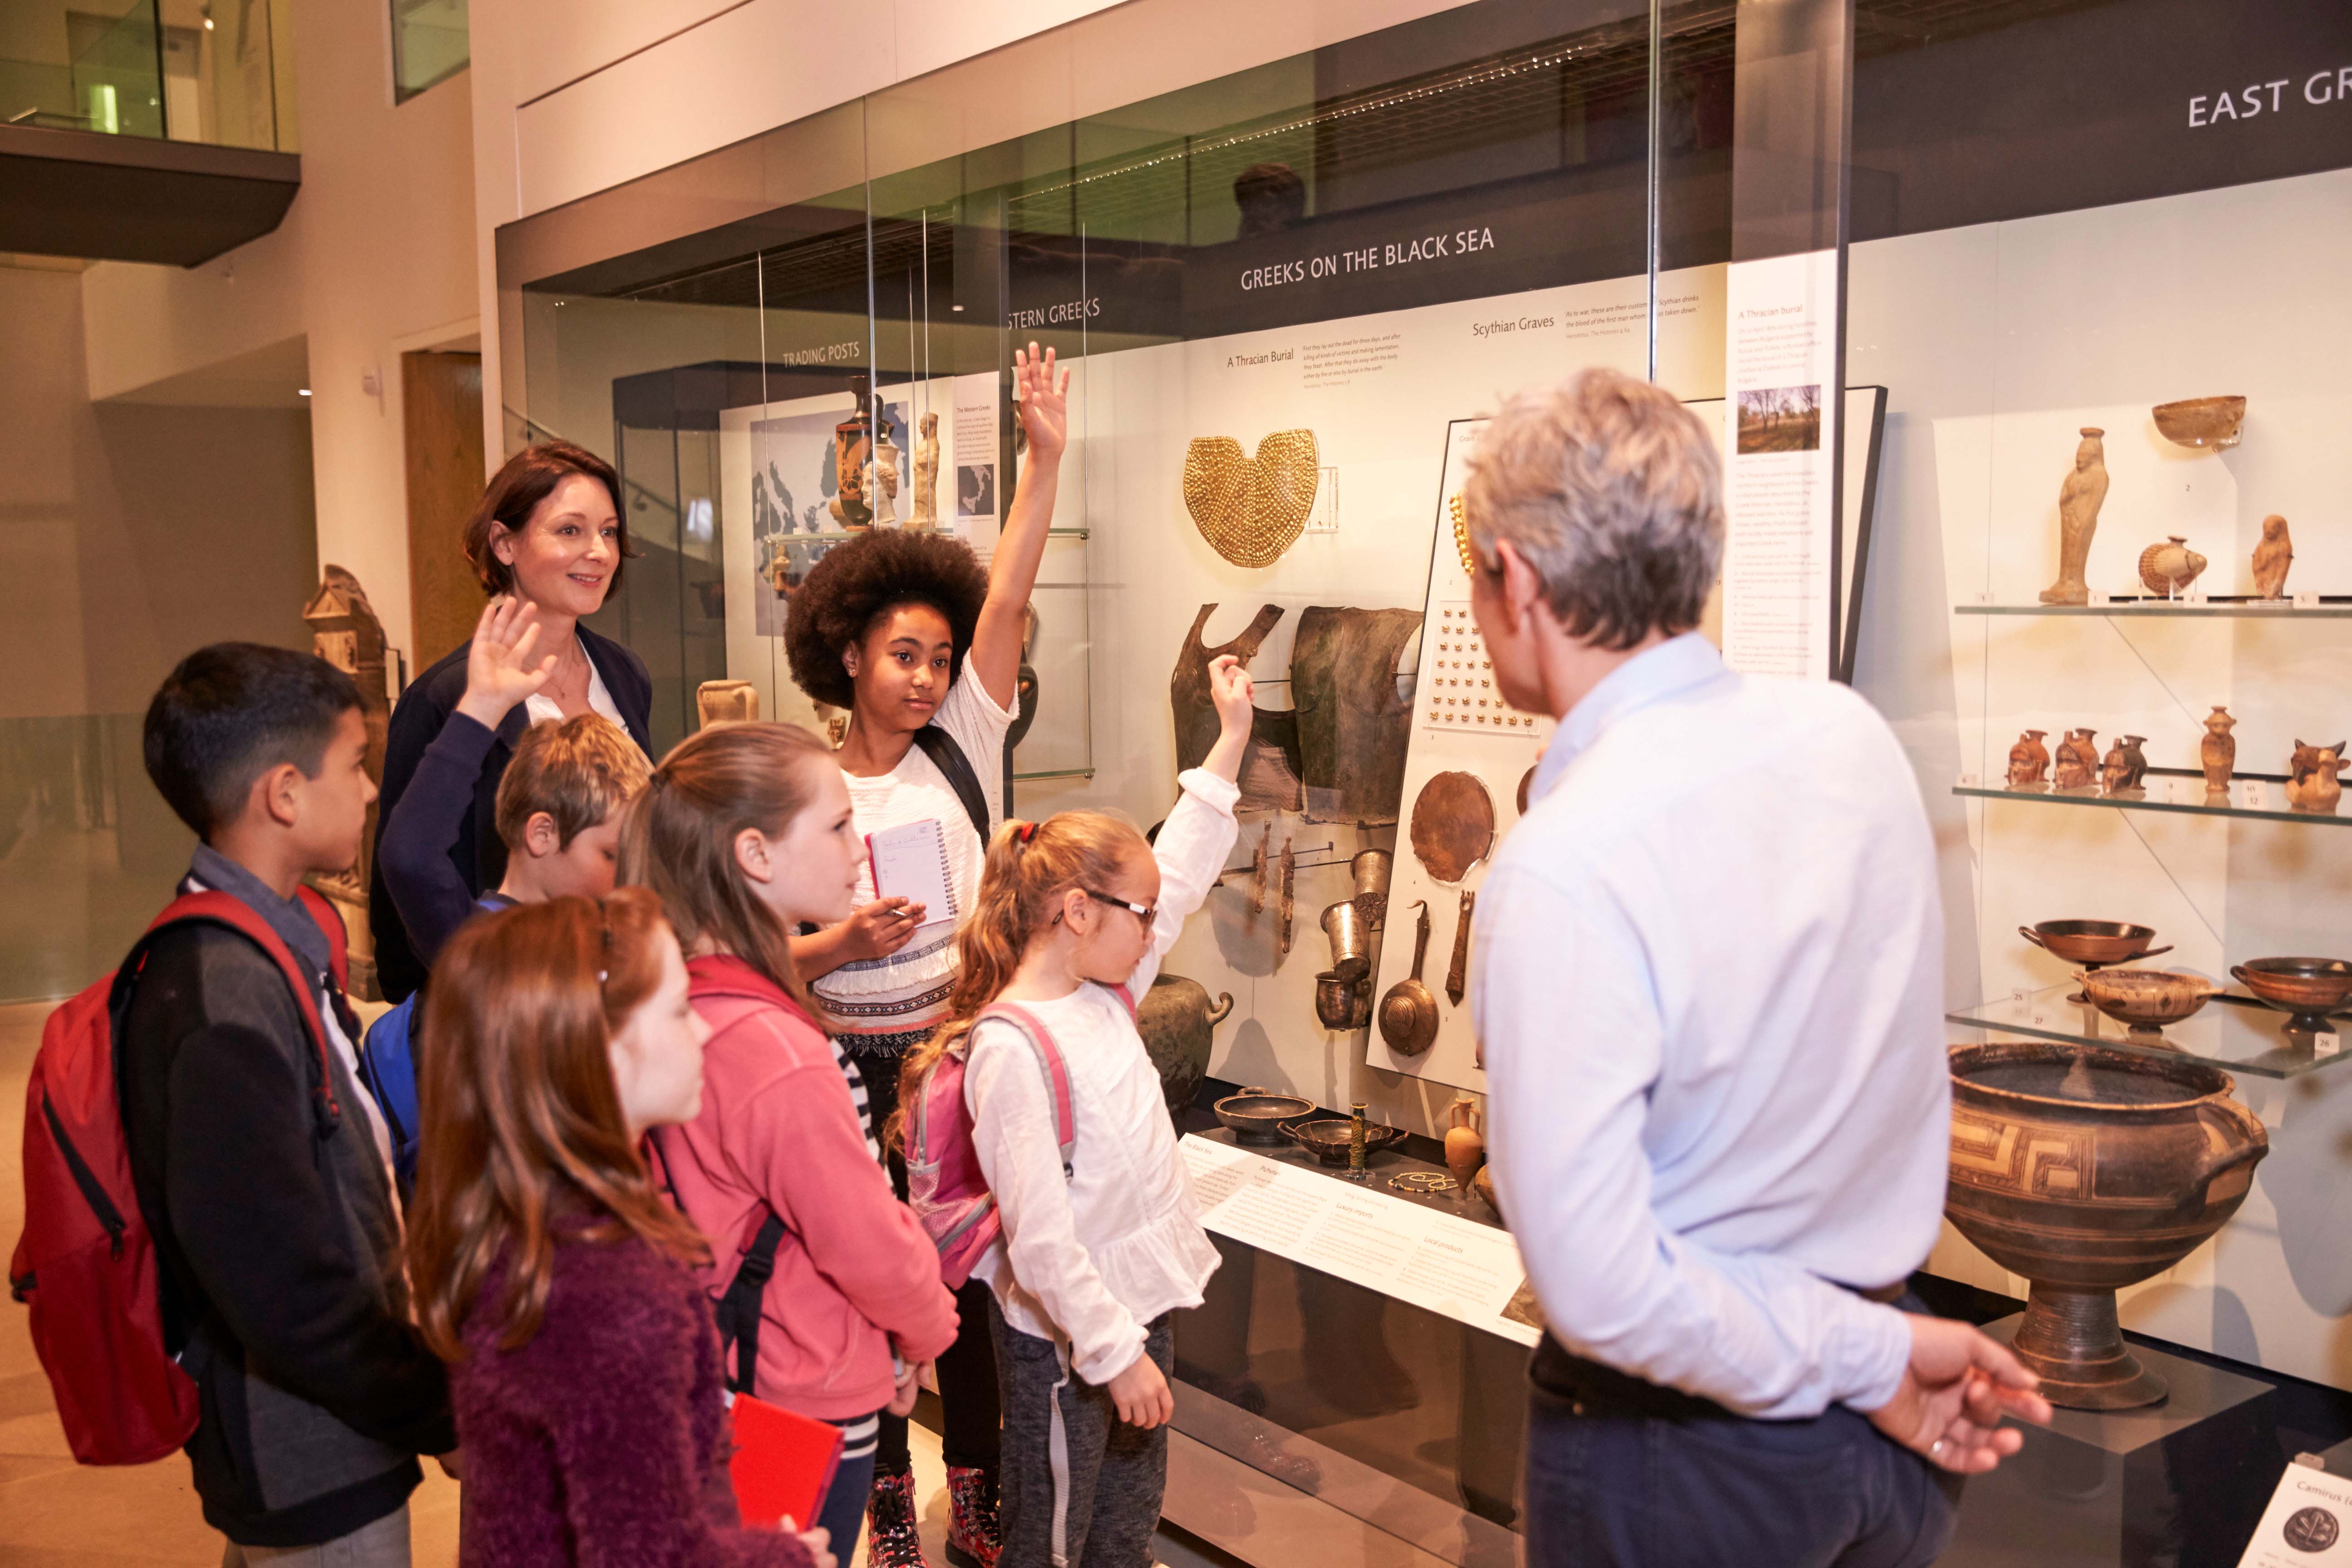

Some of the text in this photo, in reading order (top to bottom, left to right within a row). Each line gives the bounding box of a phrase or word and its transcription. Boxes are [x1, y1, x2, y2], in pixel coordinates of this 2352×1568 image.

[2189, 67, 2352, 127] EAST GR
[1241, 228, 1494, 290] GREEKS ON THE BLACK SEA
[1049, 298, 1100, 323] GREEKS
[1658, 298, 1681, 306] Scythian
[1738, 304, 1803, 319] A Thracian burial
[1473, 317, 1554, 338] Scythian Graves
[1607, 316, 1616, 324] first
[783, 341, 859, 368] TRADING POSTS
[1227, 348, 1293, 368] A Thracian Burial
[2319, 1039, 2330, 1047] 26
[1192, 1142, 1203, 1152] Black
[1336, 1202, 1373, 1219] Luxury imports
[1424, 1236, 1463, 1254] Local products
[2297, 1481, 2342, 1502] Camirus
